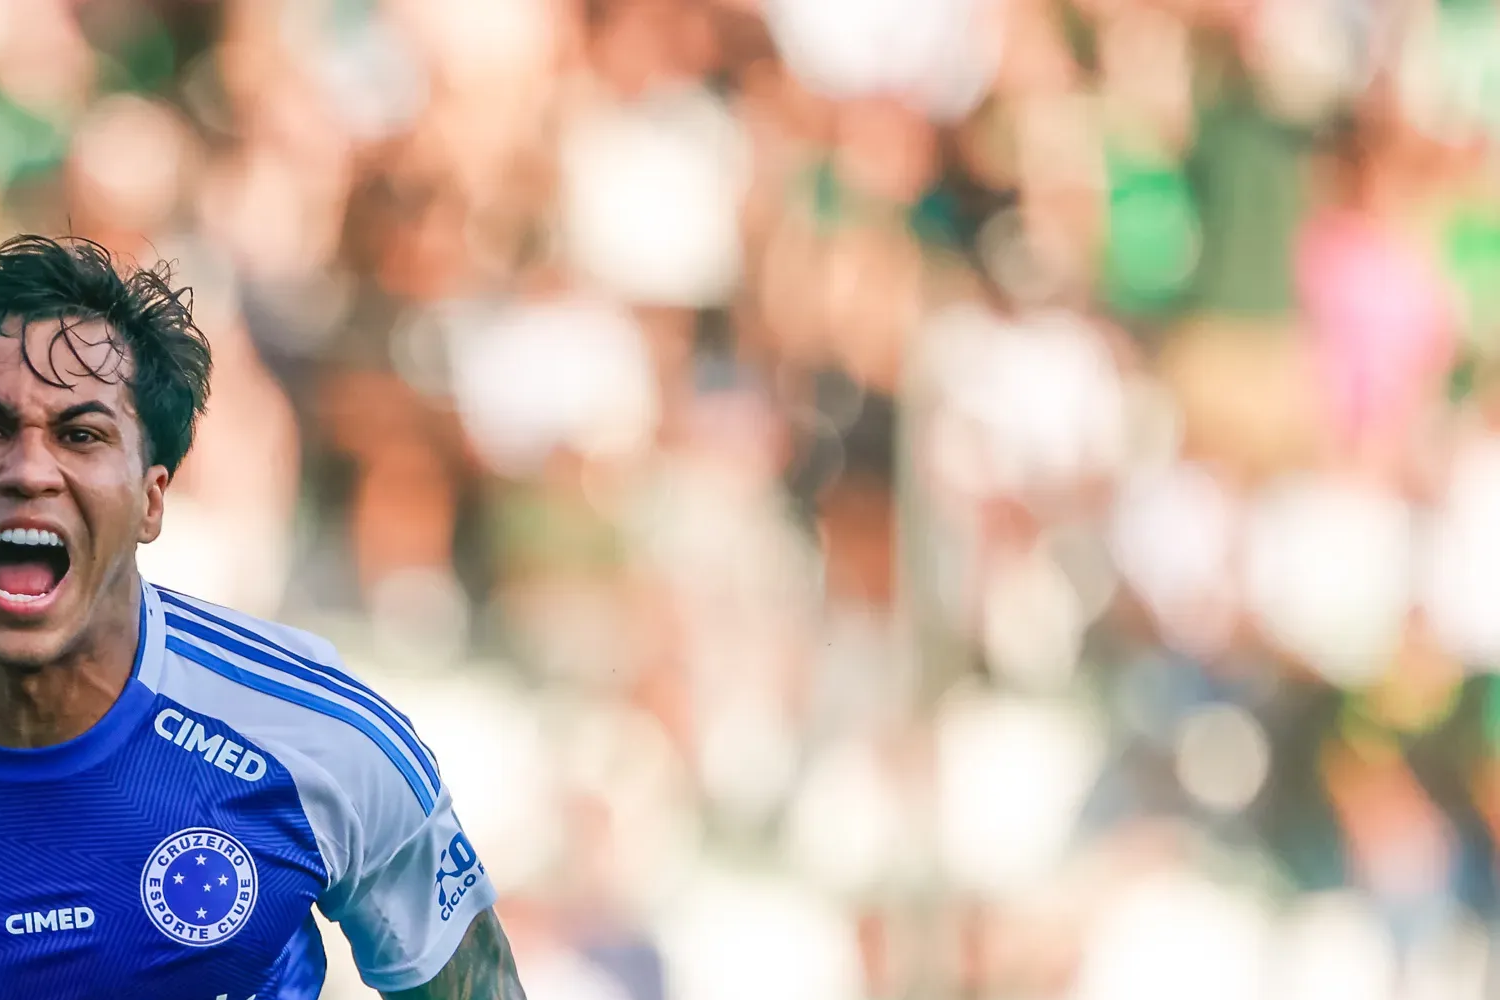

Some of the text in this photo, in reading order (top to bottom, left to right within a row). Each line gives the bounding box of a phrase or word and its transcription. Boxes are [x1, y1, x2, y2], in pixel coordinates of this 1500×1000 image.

[153, 707, 268, 782] CIMED
[157, 835, 245, 867] CRUZEIRO
[5, 906, 95, 935] CIMED
[149, 877, 251, 940] ESPORTE CLUBE
[440, 874, 477, 921] CICLO
